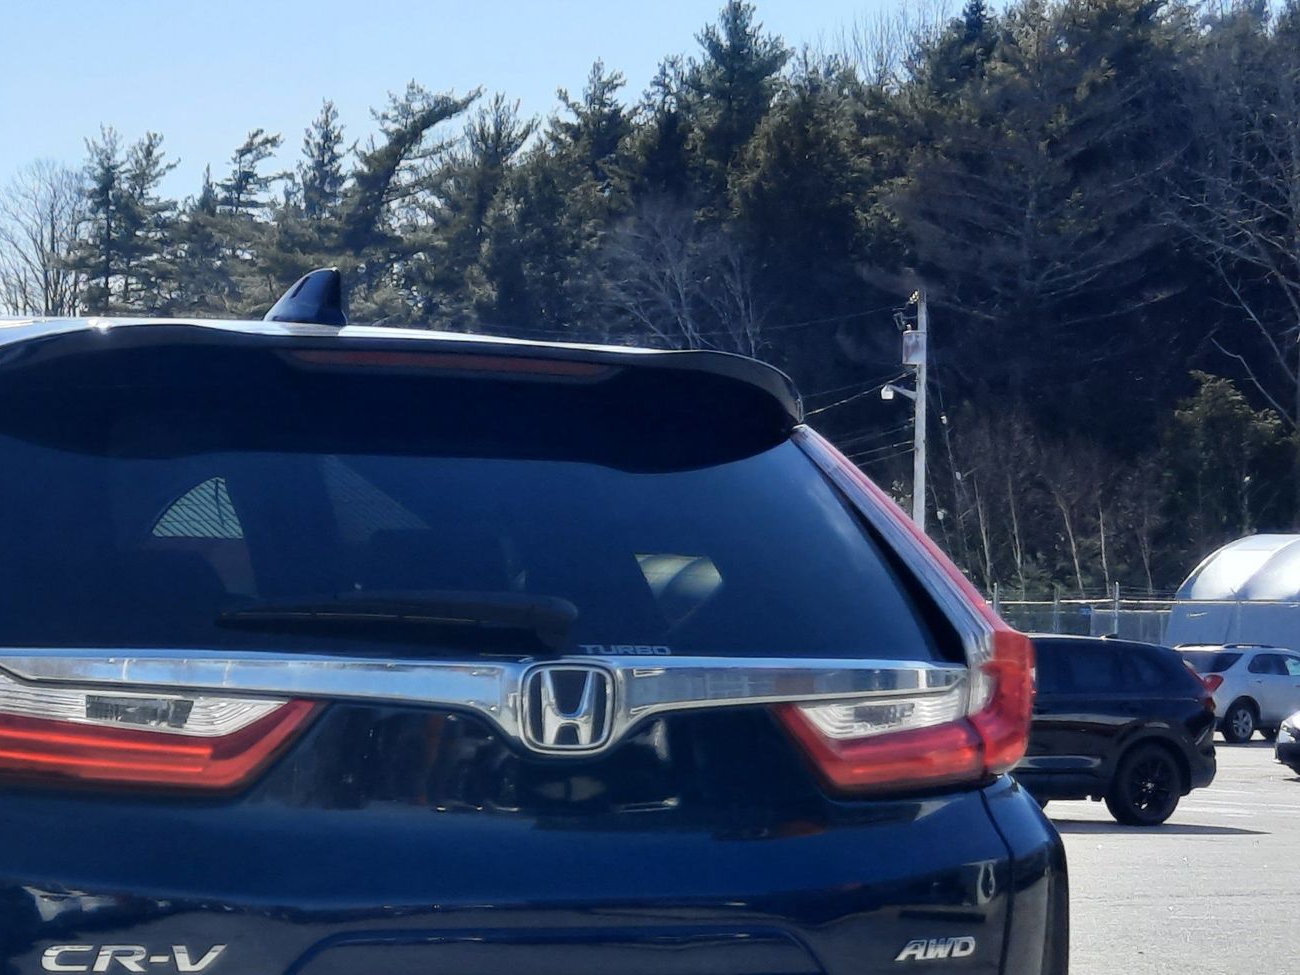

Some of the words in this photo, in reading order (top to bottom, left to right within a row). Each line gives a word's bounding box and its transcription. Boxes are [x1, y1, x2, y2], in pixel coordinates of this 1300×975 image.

[578, 644, 672, 656] TURBO
[41, 945, 228, 972] CR-V
[894, 936, 976, 961] AWD
